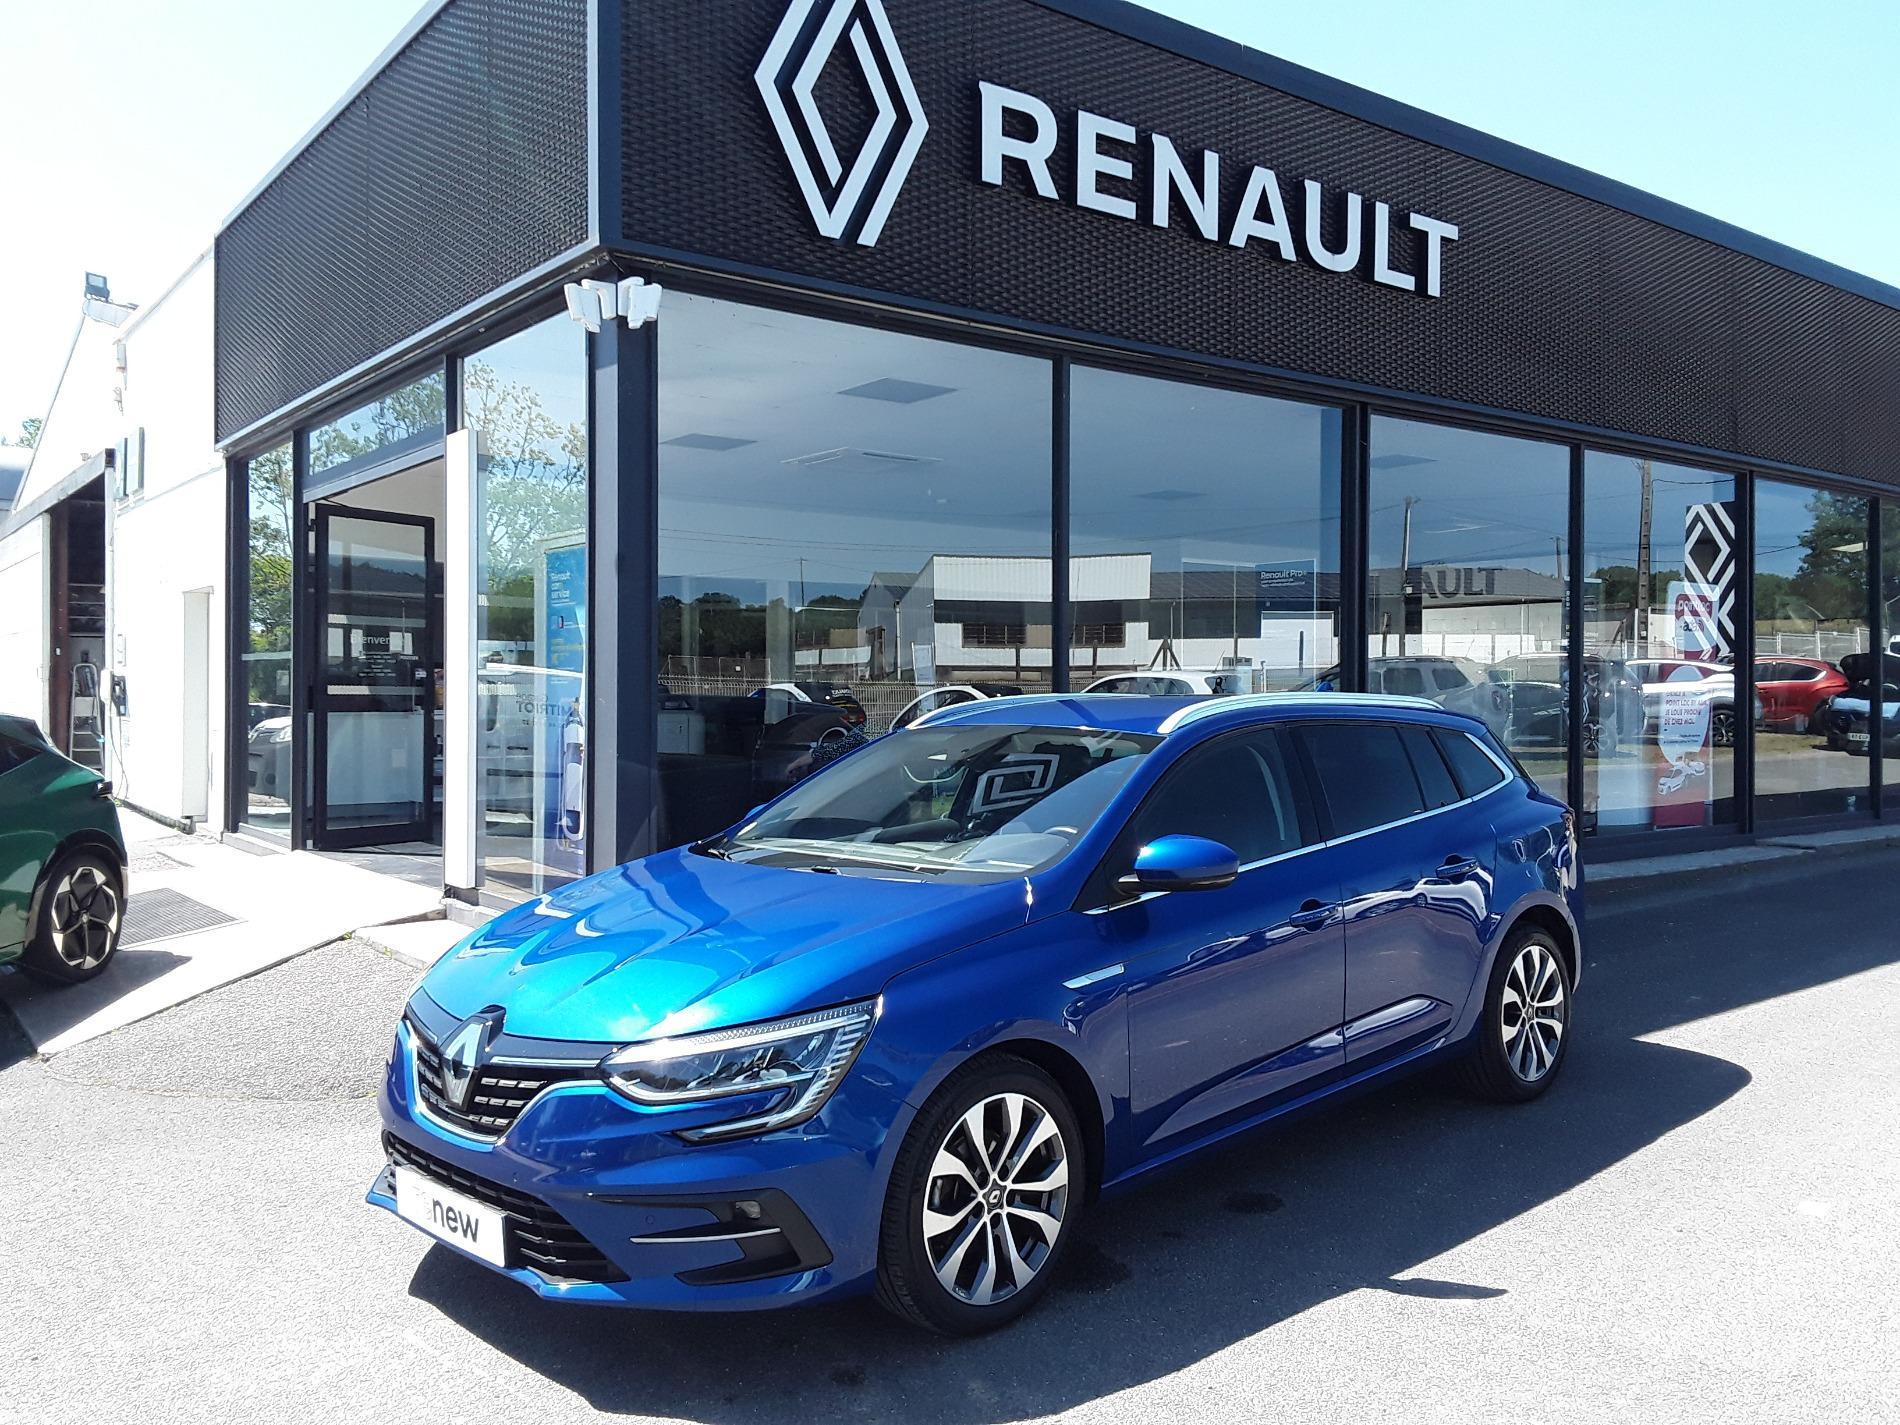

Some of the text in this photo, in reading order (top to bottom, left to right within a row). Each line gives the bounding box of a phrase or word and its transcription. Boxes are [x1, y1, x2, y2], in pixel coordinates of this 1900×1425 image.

[978, 79, 1460, 299] RENAULT
[1260, 570, 1289, 580] Renault
[432, 1197, 479, 1243] new
